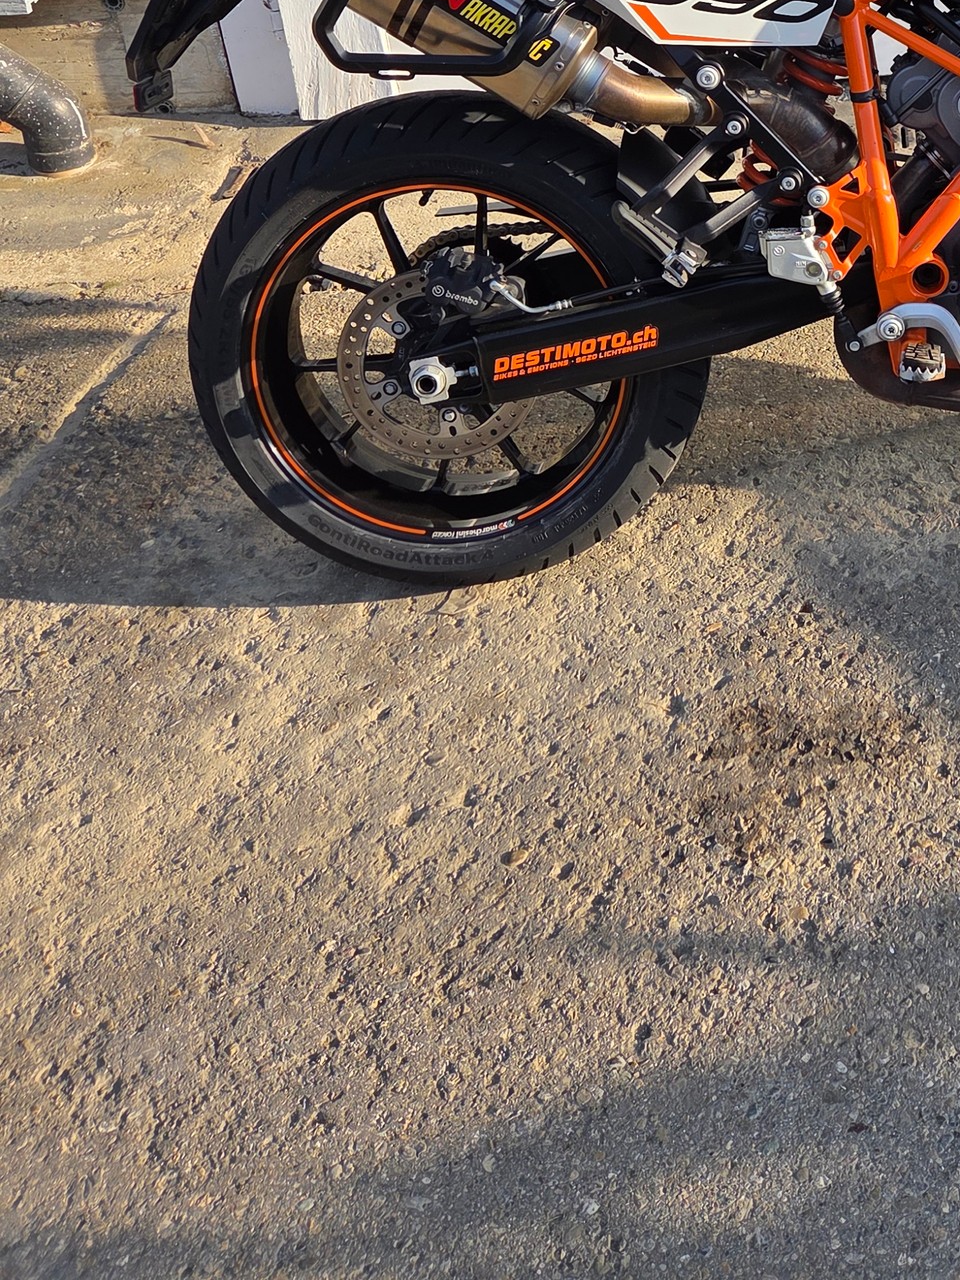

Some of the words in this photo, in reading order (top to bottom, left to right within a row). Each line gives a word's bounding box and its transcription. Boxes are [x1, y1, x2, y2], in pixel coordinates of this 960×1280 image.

[445, 289, 479, 306] brembo
[494, 325, 658, 374] DESTIMOTO.ch
[493, 370, 518, 382] BIKES
[527, 360, 569, 374] EMOTIONS
